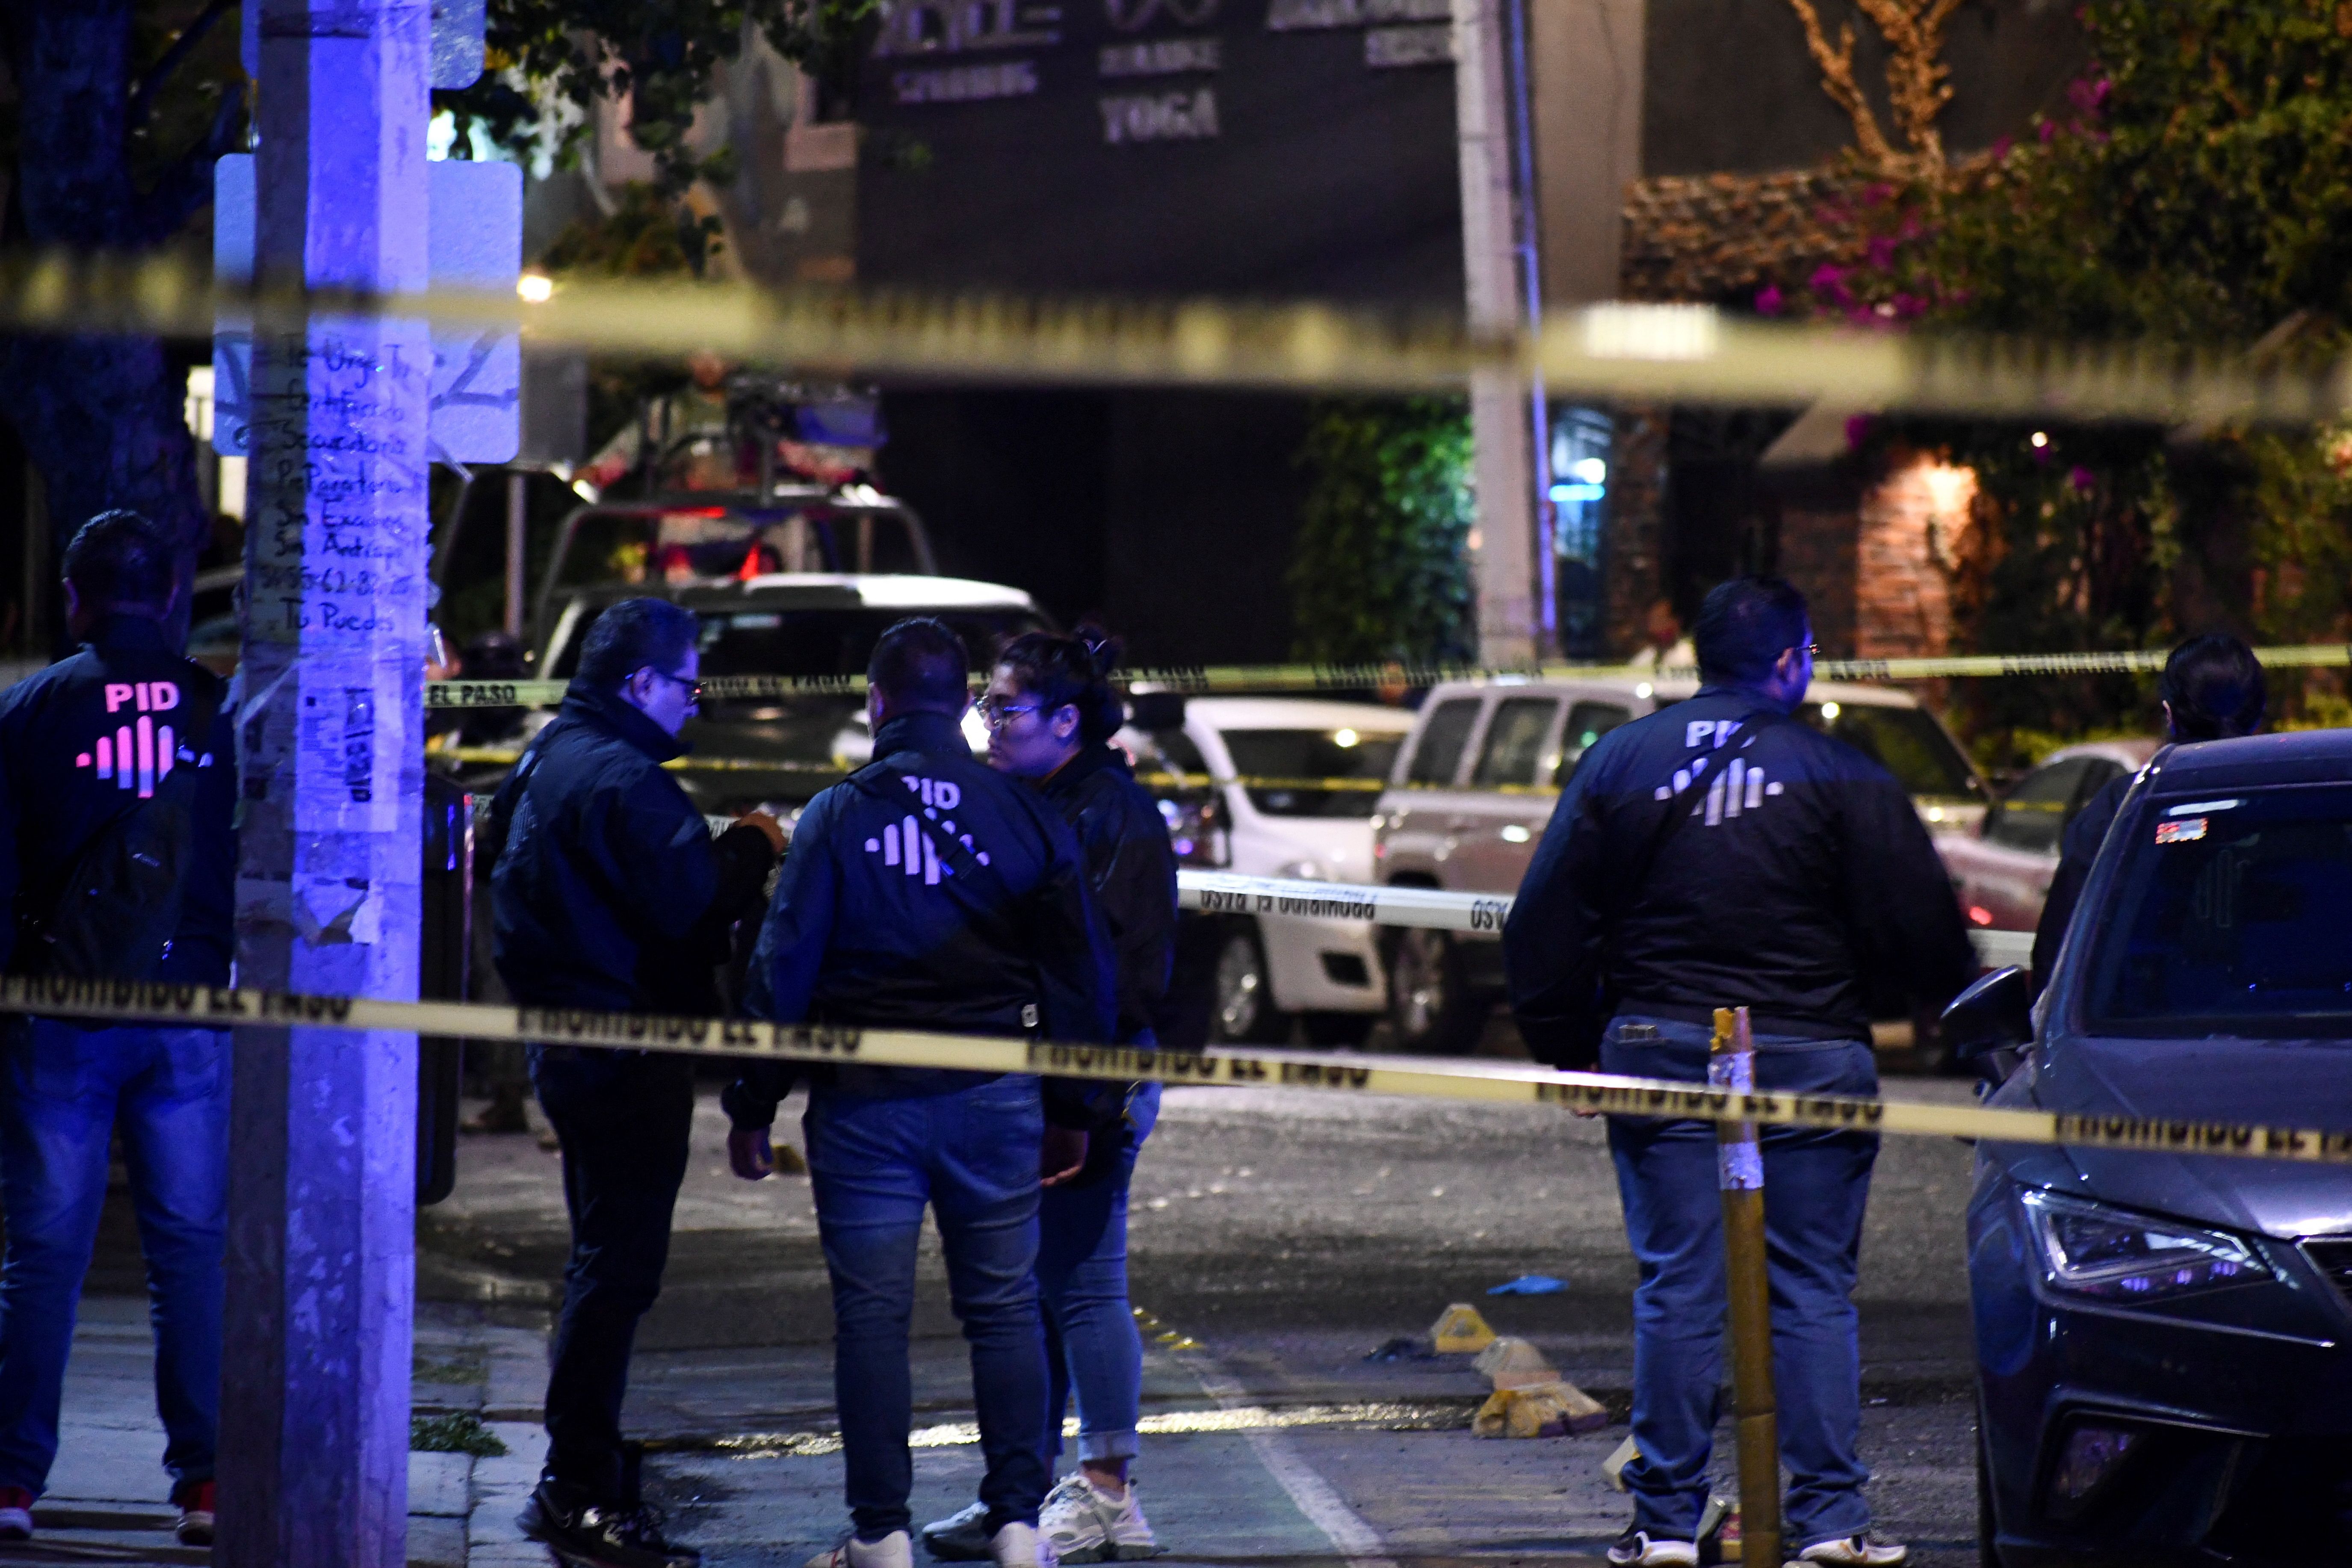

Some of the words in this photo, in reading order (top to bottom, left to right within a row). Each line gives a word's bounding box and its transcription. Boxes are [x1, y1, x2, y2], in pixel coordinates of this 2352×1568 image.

[1099, 88, 1220, 142] YOGA
[105, 681, 180, 713] PID
[431, 685, 455, 705] EL
[461, 685, 515, 705] PASO
[1685, 720, 1756, 748] PI
